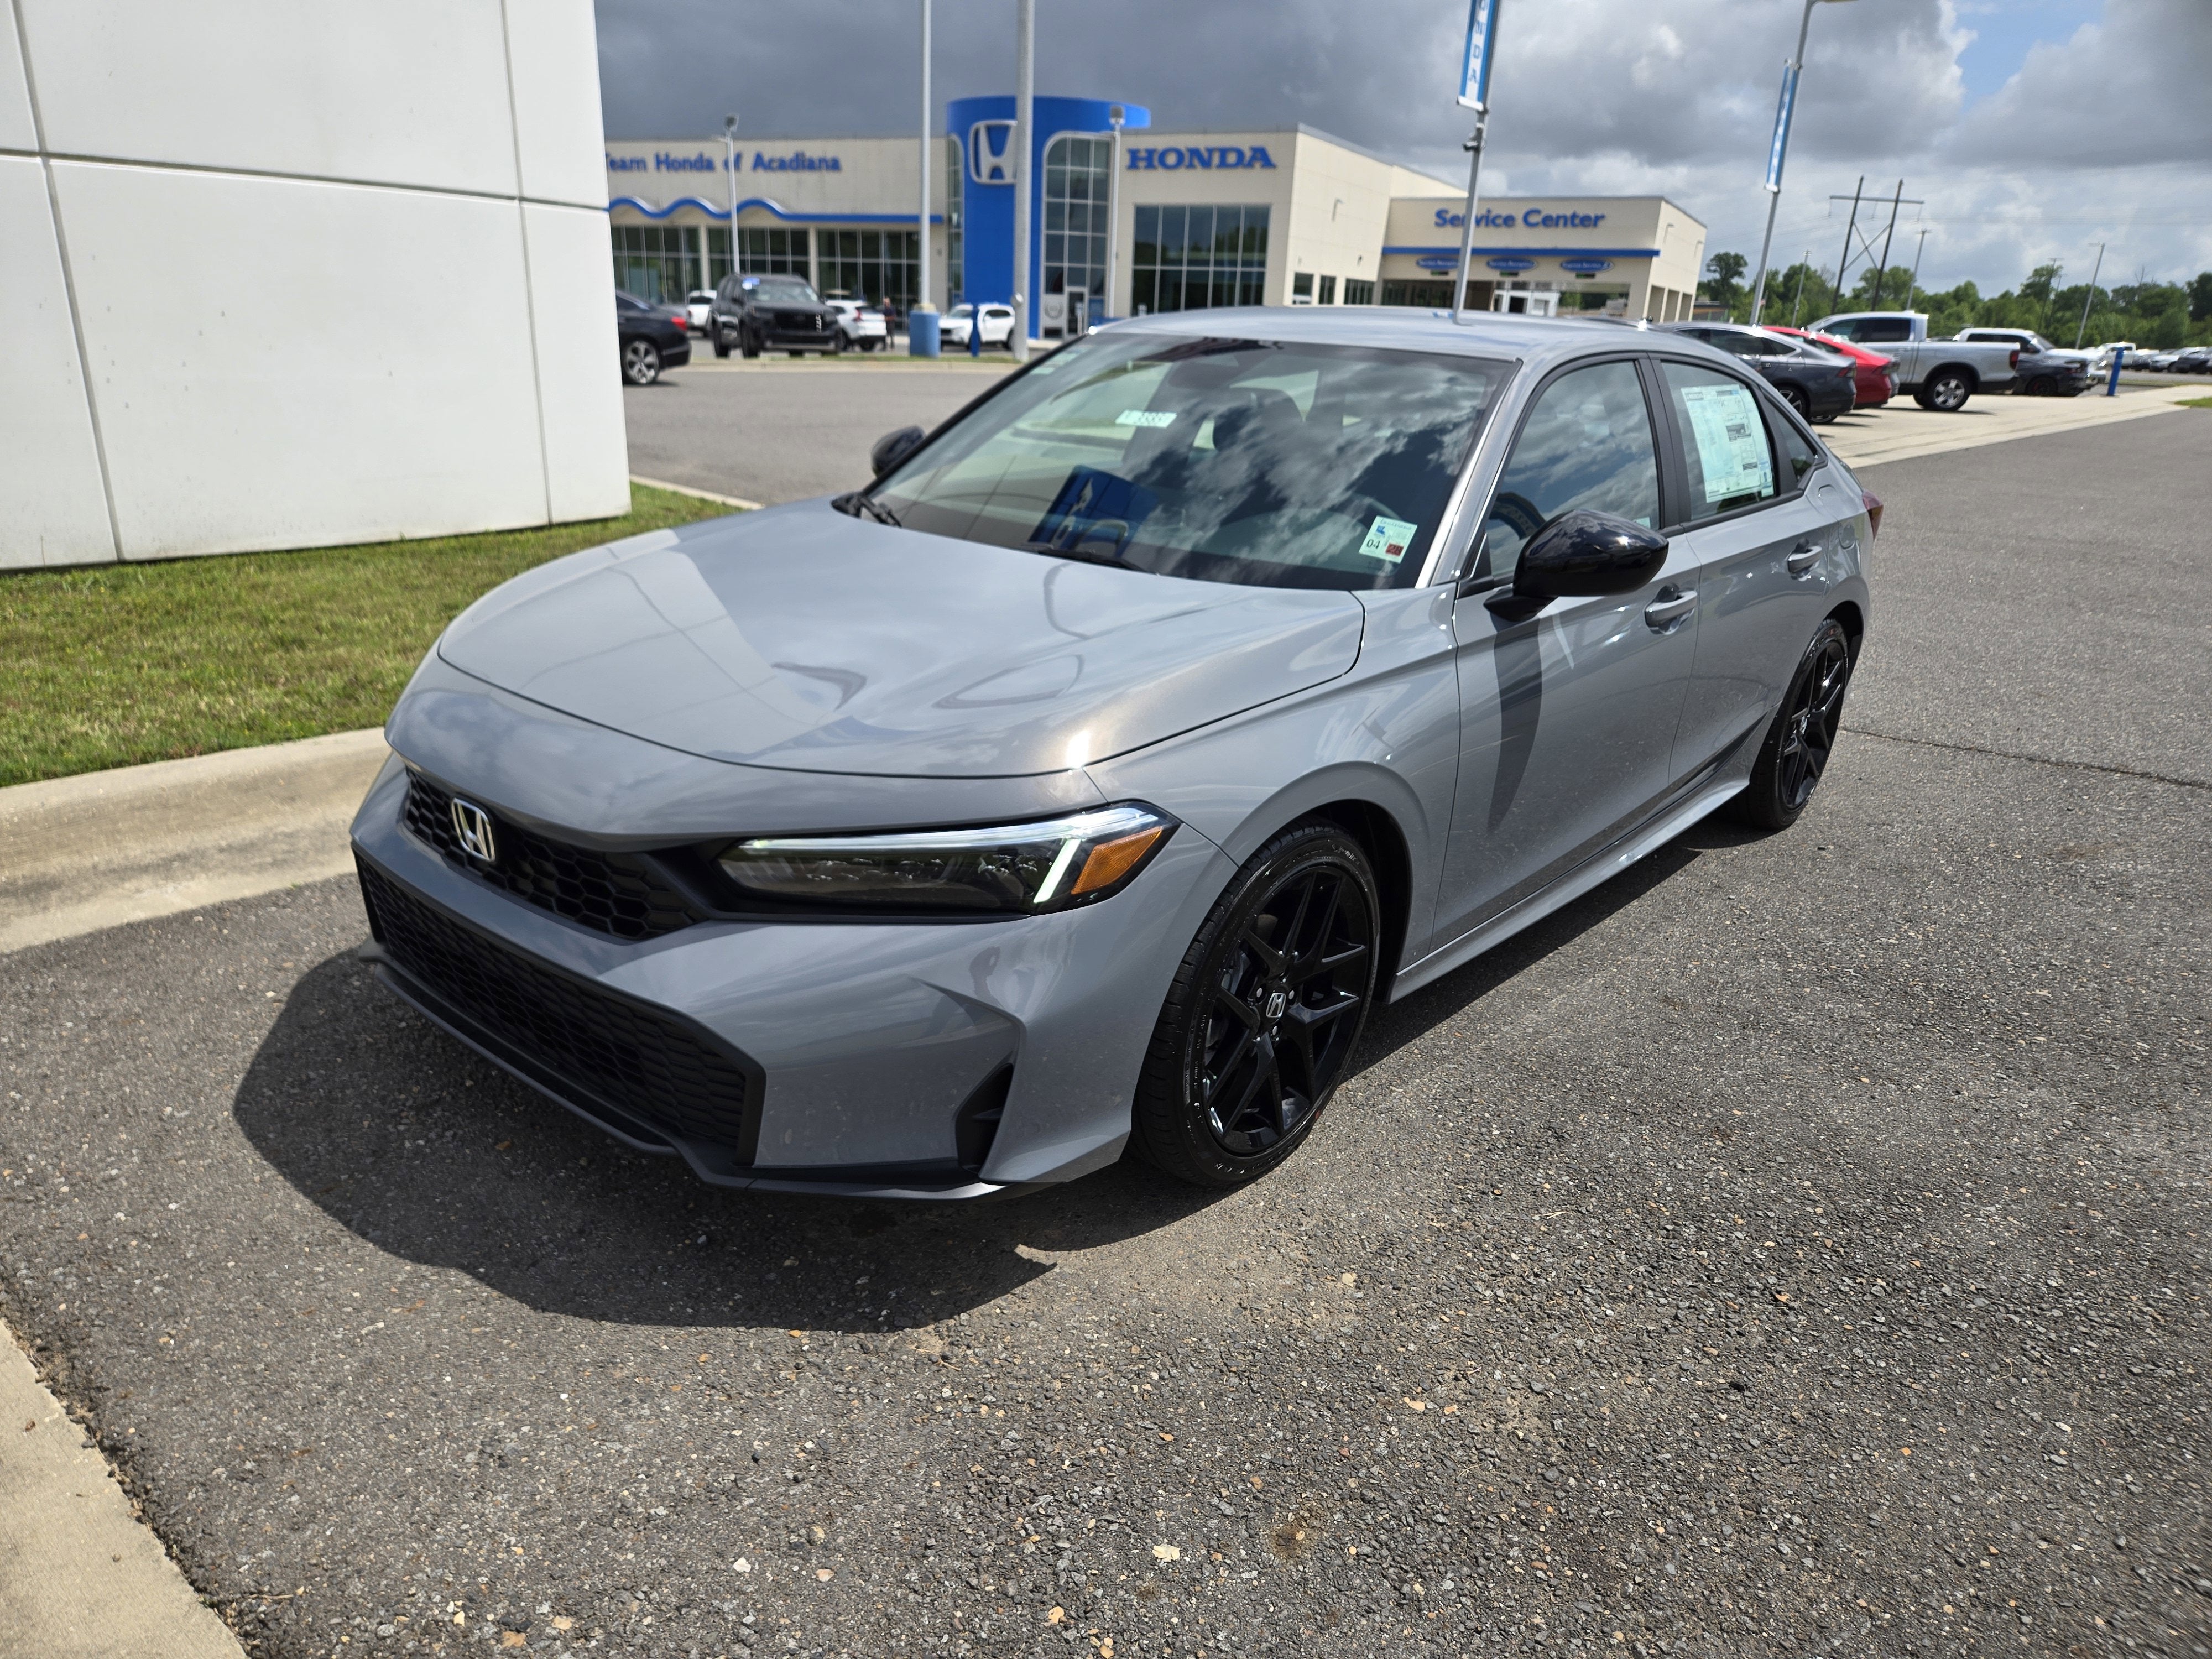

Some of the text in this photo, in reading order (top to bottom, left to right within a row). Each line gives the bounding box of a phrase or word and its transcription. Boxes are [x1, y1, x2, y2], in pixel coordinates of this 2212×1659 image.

[605, 152, 648, 172] eam
[654, 152, 715, 172] Honda
[752, 151, 842, 172] Acadiana
[1127, 146, 1277, 170] HONDA
[1522, 208, 1606, 228] Center
[1366, 539, 1380, 549] 04
